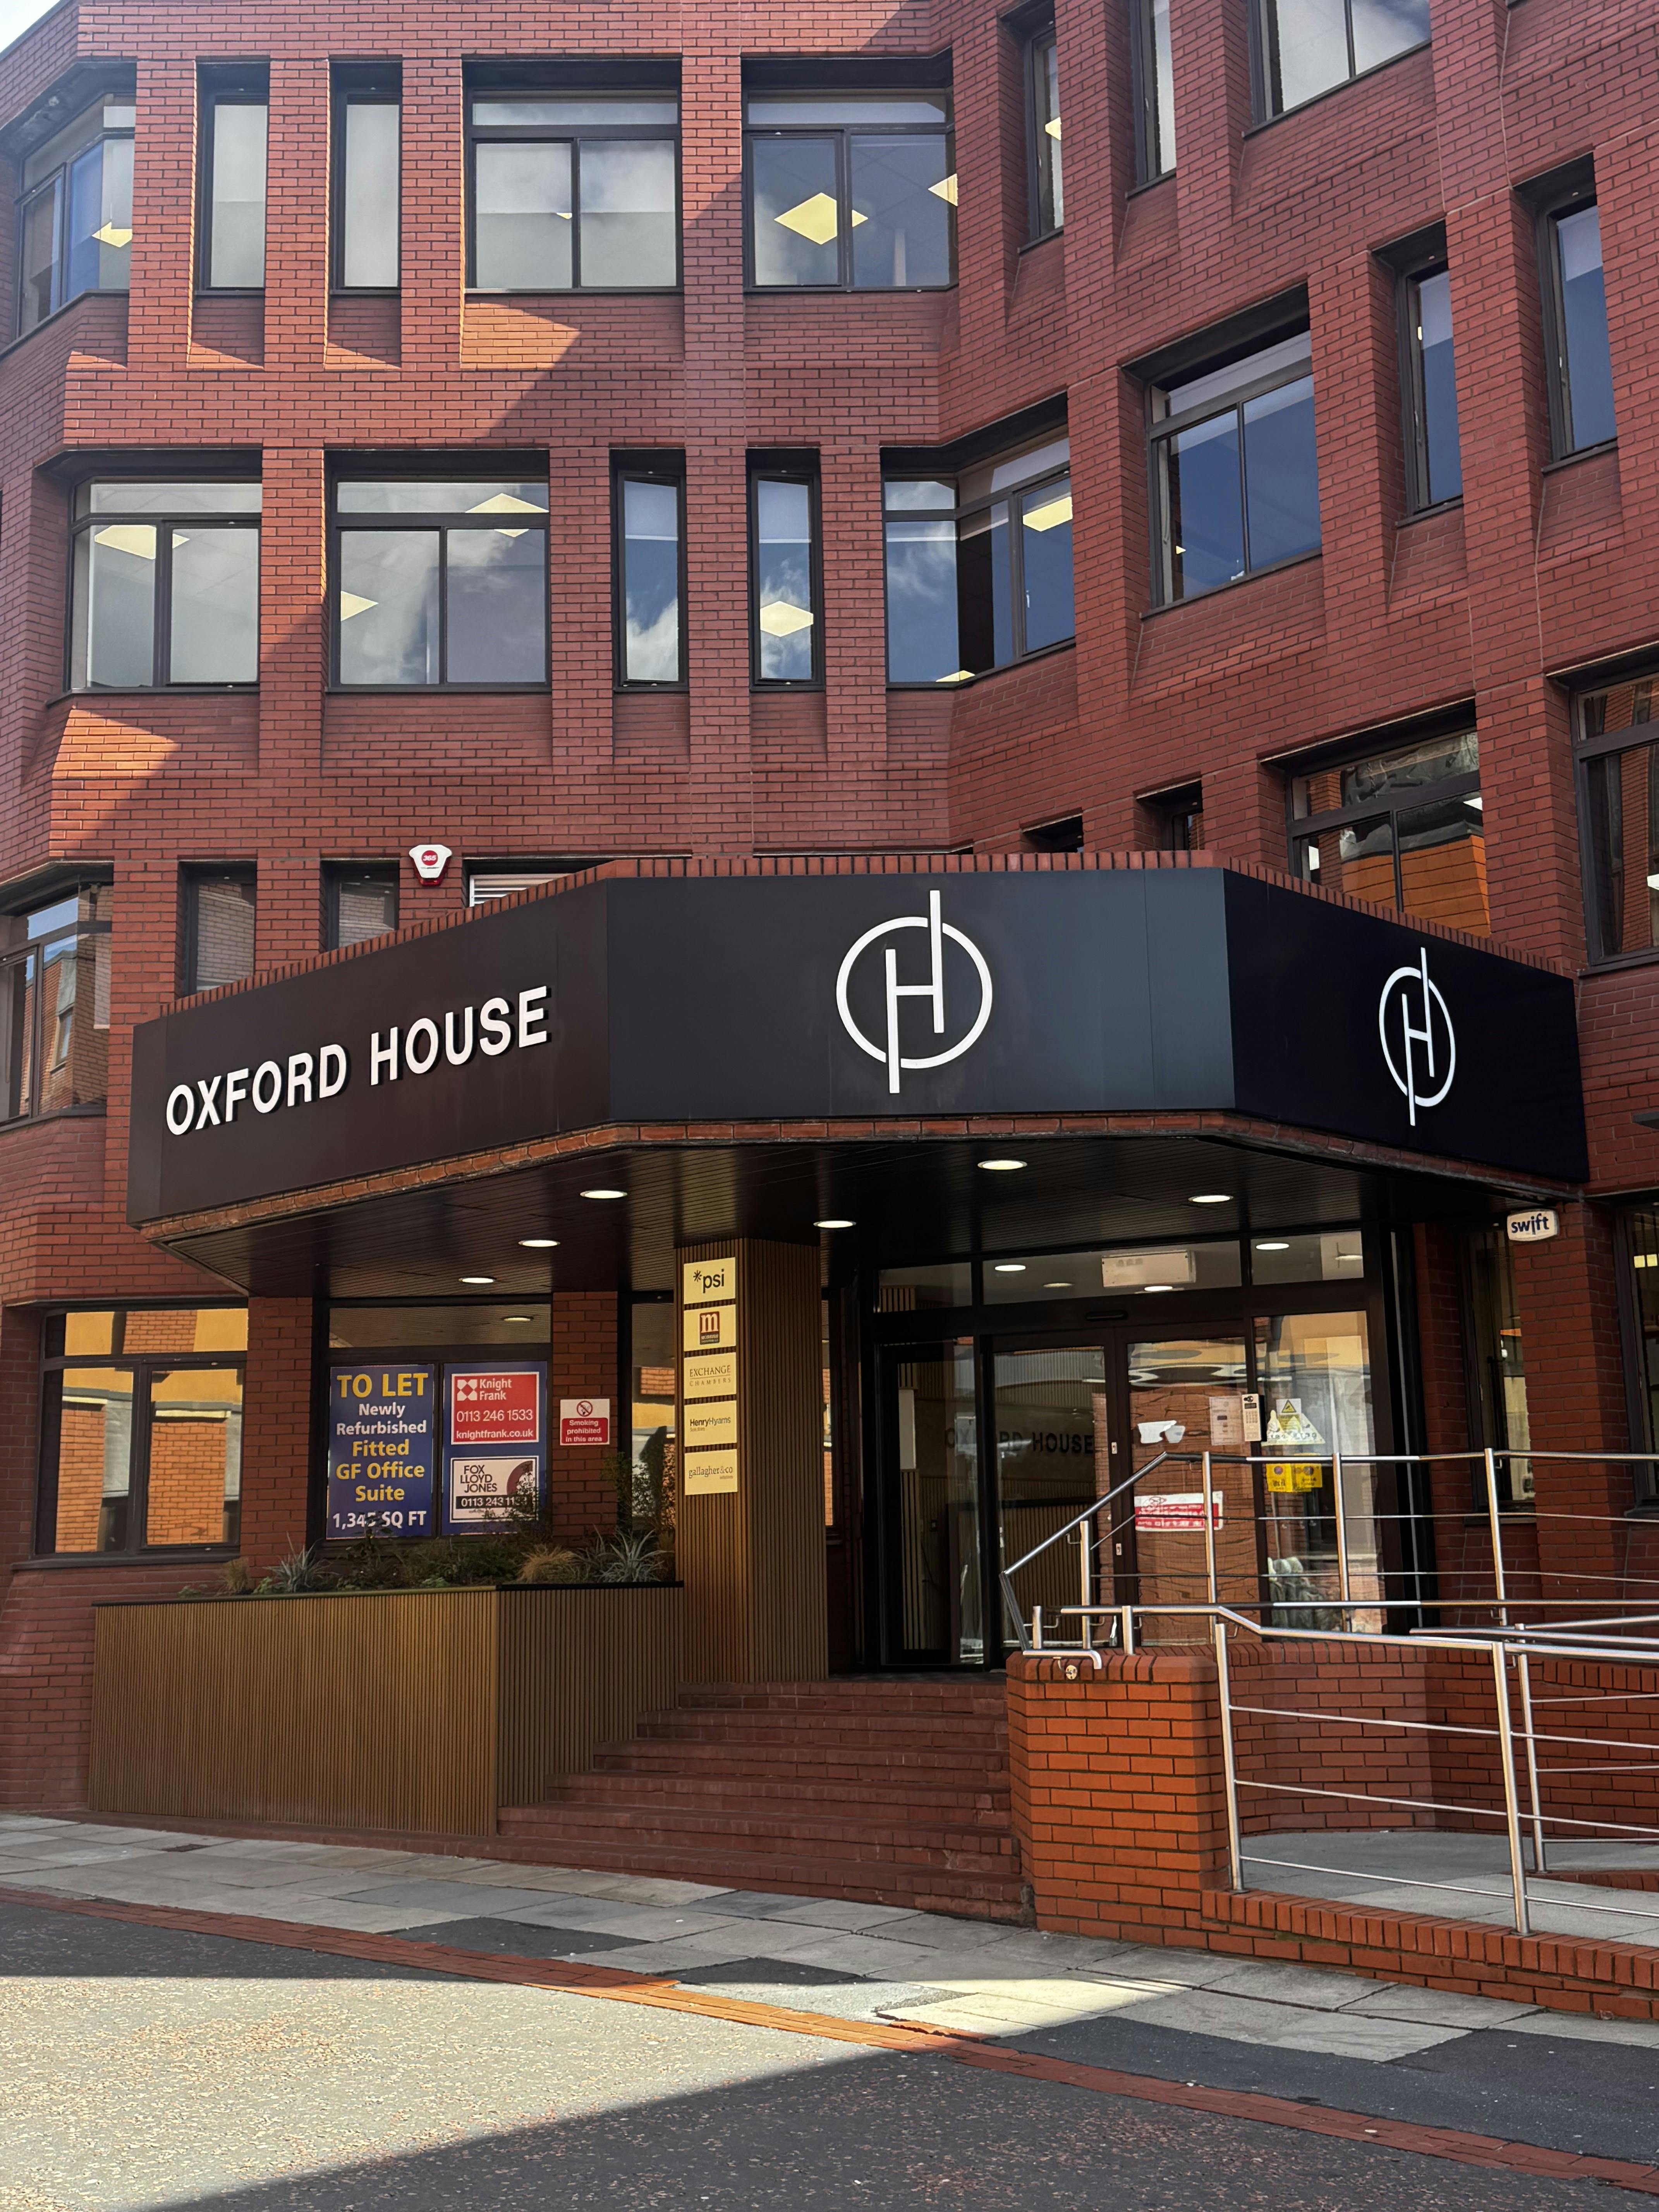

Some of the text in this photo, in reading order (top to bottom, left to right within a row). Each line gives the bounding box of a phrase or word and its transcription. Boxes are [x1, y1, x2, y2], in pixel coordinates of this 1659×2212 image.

[166, 986, 546, 1135] OXFORD HOUSE
[1511, 1213, 1549, 1235] swift
[690, 1365, 731, 1377] EXCHANGE
[337, 1373, 428, 1398] TO LET
[480, 1378, 512, 1391] Knight
[690, 1377, 731, 1386] CHAMBERS
[480, 1391, 507, 1400] Frank
[359, 1402, 405, 1418] Newly
[457, 1409, 533, 1422] 0113 246 1533
[336, 1420, 426, 1435] Refurbished
[567, 1427, 601, 1436] prohibited
[456, 1429, 533, 1440] knightfrank.co.uk
[352, 1439, 409, 1456] Fitted
[1032, 1432, 1094, 1454] HOUSE
[336, 1461, 425, 1479] GF Office
[464, 1465, 485, 1474] FOX
[460, 1474, 493, 1484] LLOYD
[356, 1484, 405, 1502] Suite
[464, 1483, 497, 1493] JONES
[461, 1498, 483, 1507] 0113
[381, 1511, 403, 1528] SQ
[409, 1511, 426, 1526] FT
